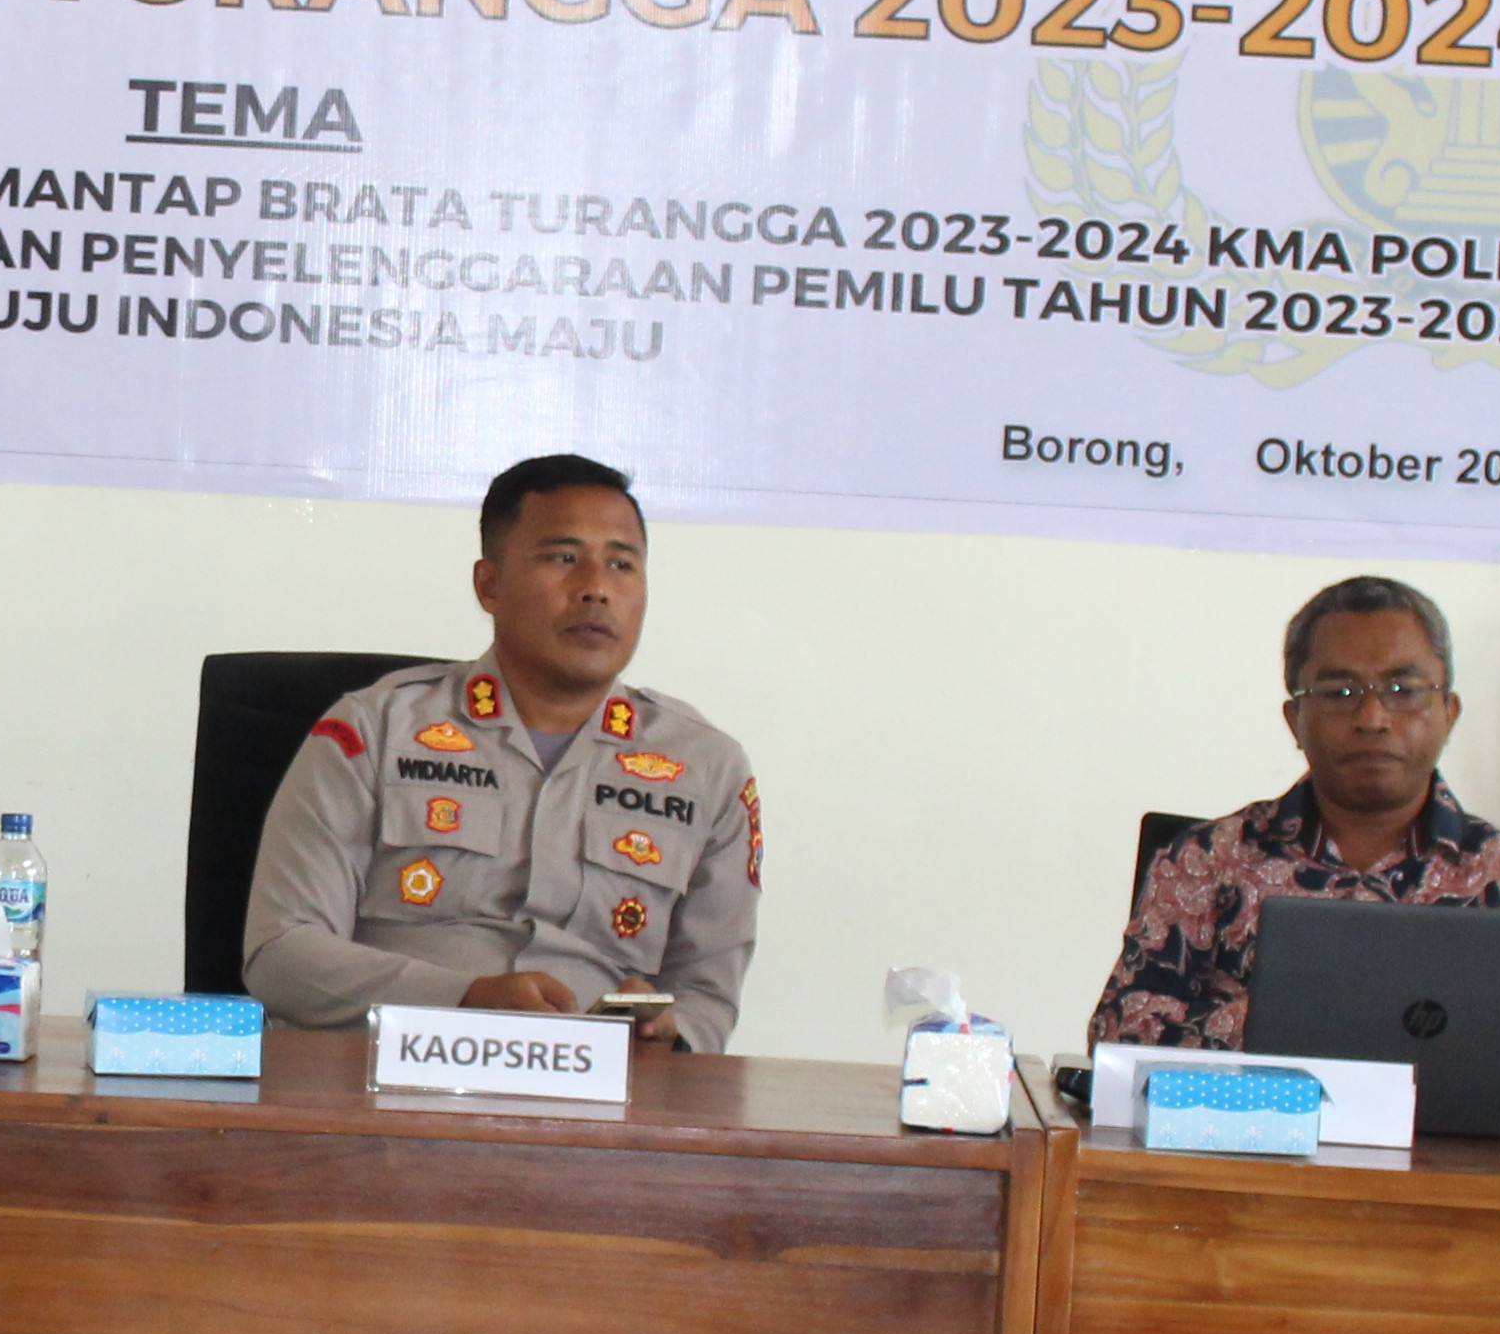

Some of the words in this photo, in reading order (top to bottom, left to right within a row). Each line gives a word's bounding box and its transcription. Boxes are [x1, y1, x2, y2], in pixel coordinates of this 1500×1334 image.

[128, 78, 363, 144] TEMA
[260, 179, 473, 231] BRATA
[490, 190, 847, 248] TURANGGA
[864, 208, 1189, 266] 2023-2024
[1208, 227, 1353, 274] KMA
[81, 233, 732, 304] PENYELENGGARAAN
[752, 265, 985, 316] PEMILU
[1004, 278, 1226, 329] TAHUN
[117, 295, 467, 353] INDONESIA
[486, 313, 663, 361] MAJU
[1002, 425, 1184, 477] Borong,
[1256, 438, 1441, 484] Oktober
[398, 757, 499, 789] WIDIARTA
[595, 784, 694, 825] POLRI
[399, 1033, 593, 1073] KAOPSRES
